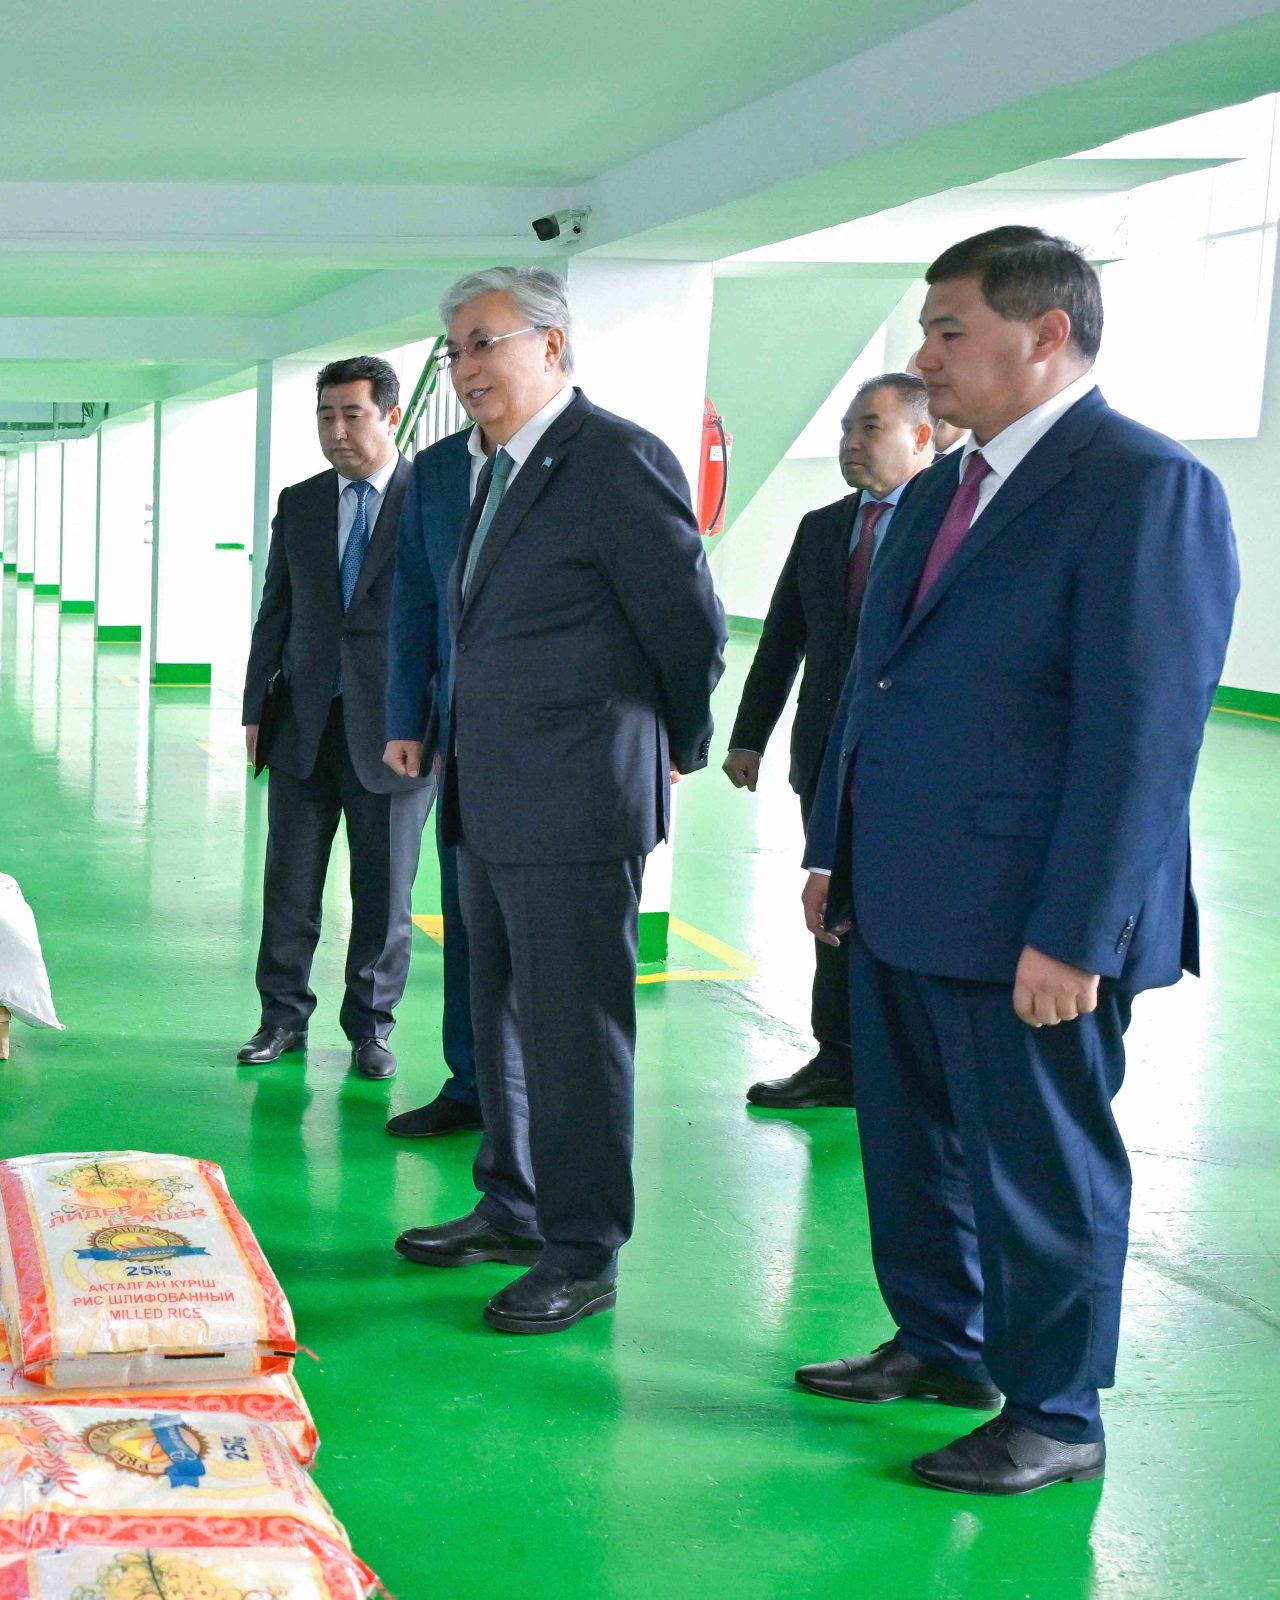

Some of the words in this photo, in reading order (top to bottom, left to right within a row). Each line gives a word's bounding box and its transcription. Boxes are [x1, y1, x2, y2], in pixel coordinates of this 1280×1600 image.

[49, 1205, 133, 1228] ЛИДЕР
[107, 1208, 208, 1227] LEADER
[126, 1266, 153, 1276] 25
[73, 1295, 103, 1307] РИС
[109, 1290, 234, 1305] ШЛИФОВАННЫЙ
[109, 1308, 163, 1320] MILLED
[168, 1307, 202, 1319] RICE
[225, 1443, 250, 1461] 25
